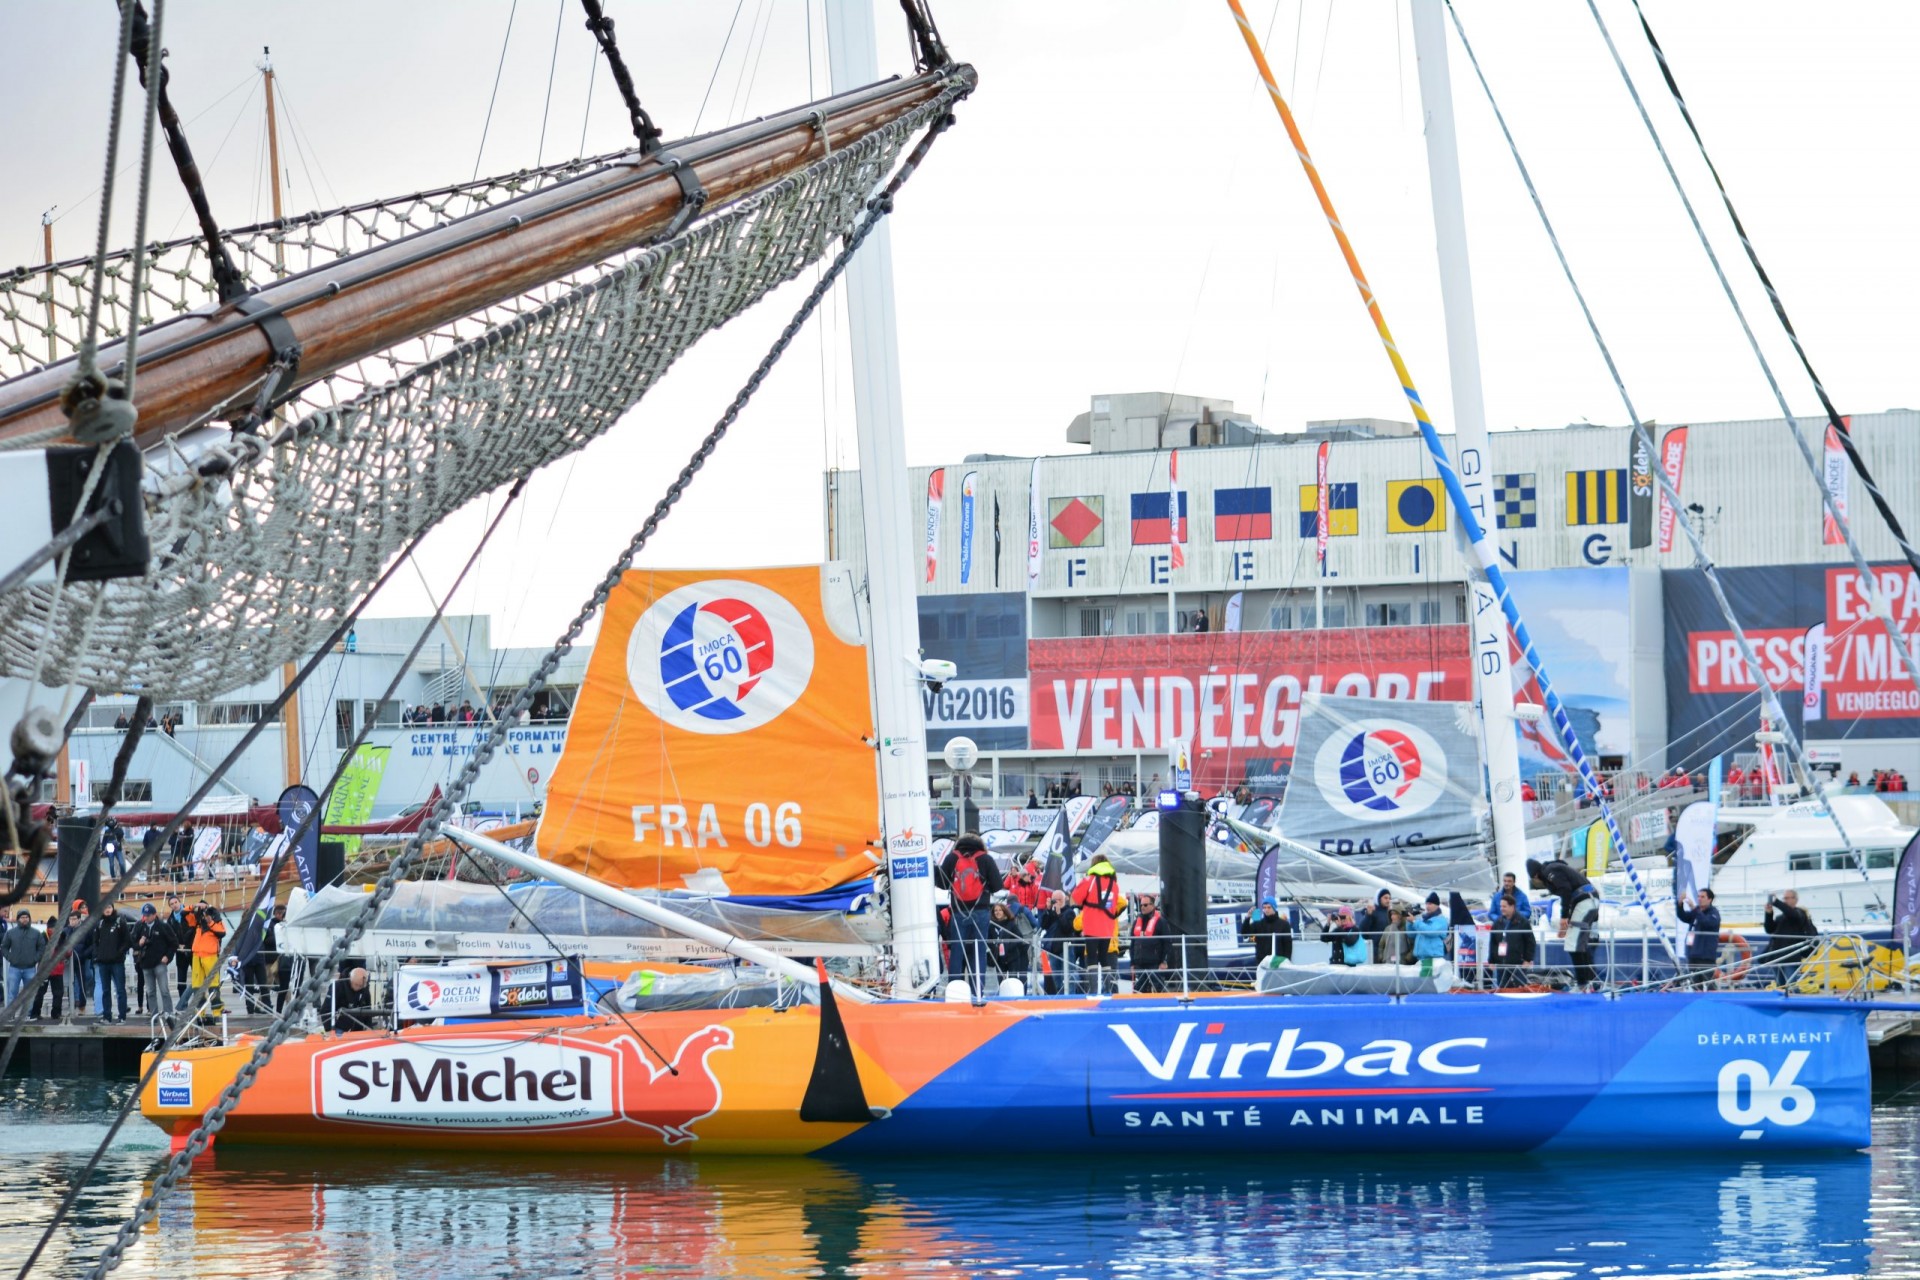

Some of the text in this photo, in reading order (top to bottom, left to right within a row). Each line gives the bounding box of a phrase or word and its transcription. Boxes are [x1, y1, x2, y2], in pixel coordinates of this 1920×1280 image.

[698, 634, 735, 656] IMOCA
[1480, 633, 1501, 676] 16
[704, 646, 742, 681] 60
[411, 733, 457, 744] CENTRE
[411, 746, 433, 756] AUX
[529, 744, 543, 753] LA
[1367, 753, 1393, 768] IMOCA
[1372, 760, 1400, 785] 60
[631, 801, 802, 848] FRA 06
[980, 814, 1000, 823] ENDÉE
[385, 938, 417, 948] Altana
[497, 940, 532, 950] Valtus
[442, 995, 480, 1004] MASTERS
[443, 986, 481, 997] OCEAN
[1697, 1032, 1833, 1045] DÉPARTEMENT
[1107, 1022, 1488, 1081] Virbac
[161, 1089, 188, 1097] Virbac
[1717, 1050, 1816, 1127] 06
[505, 1114, 557, 1125] depuis
[559, 1107, 590, 1118] 1905
[1124, 1105, 1484, 1128] SANTÉ ANIMALE
